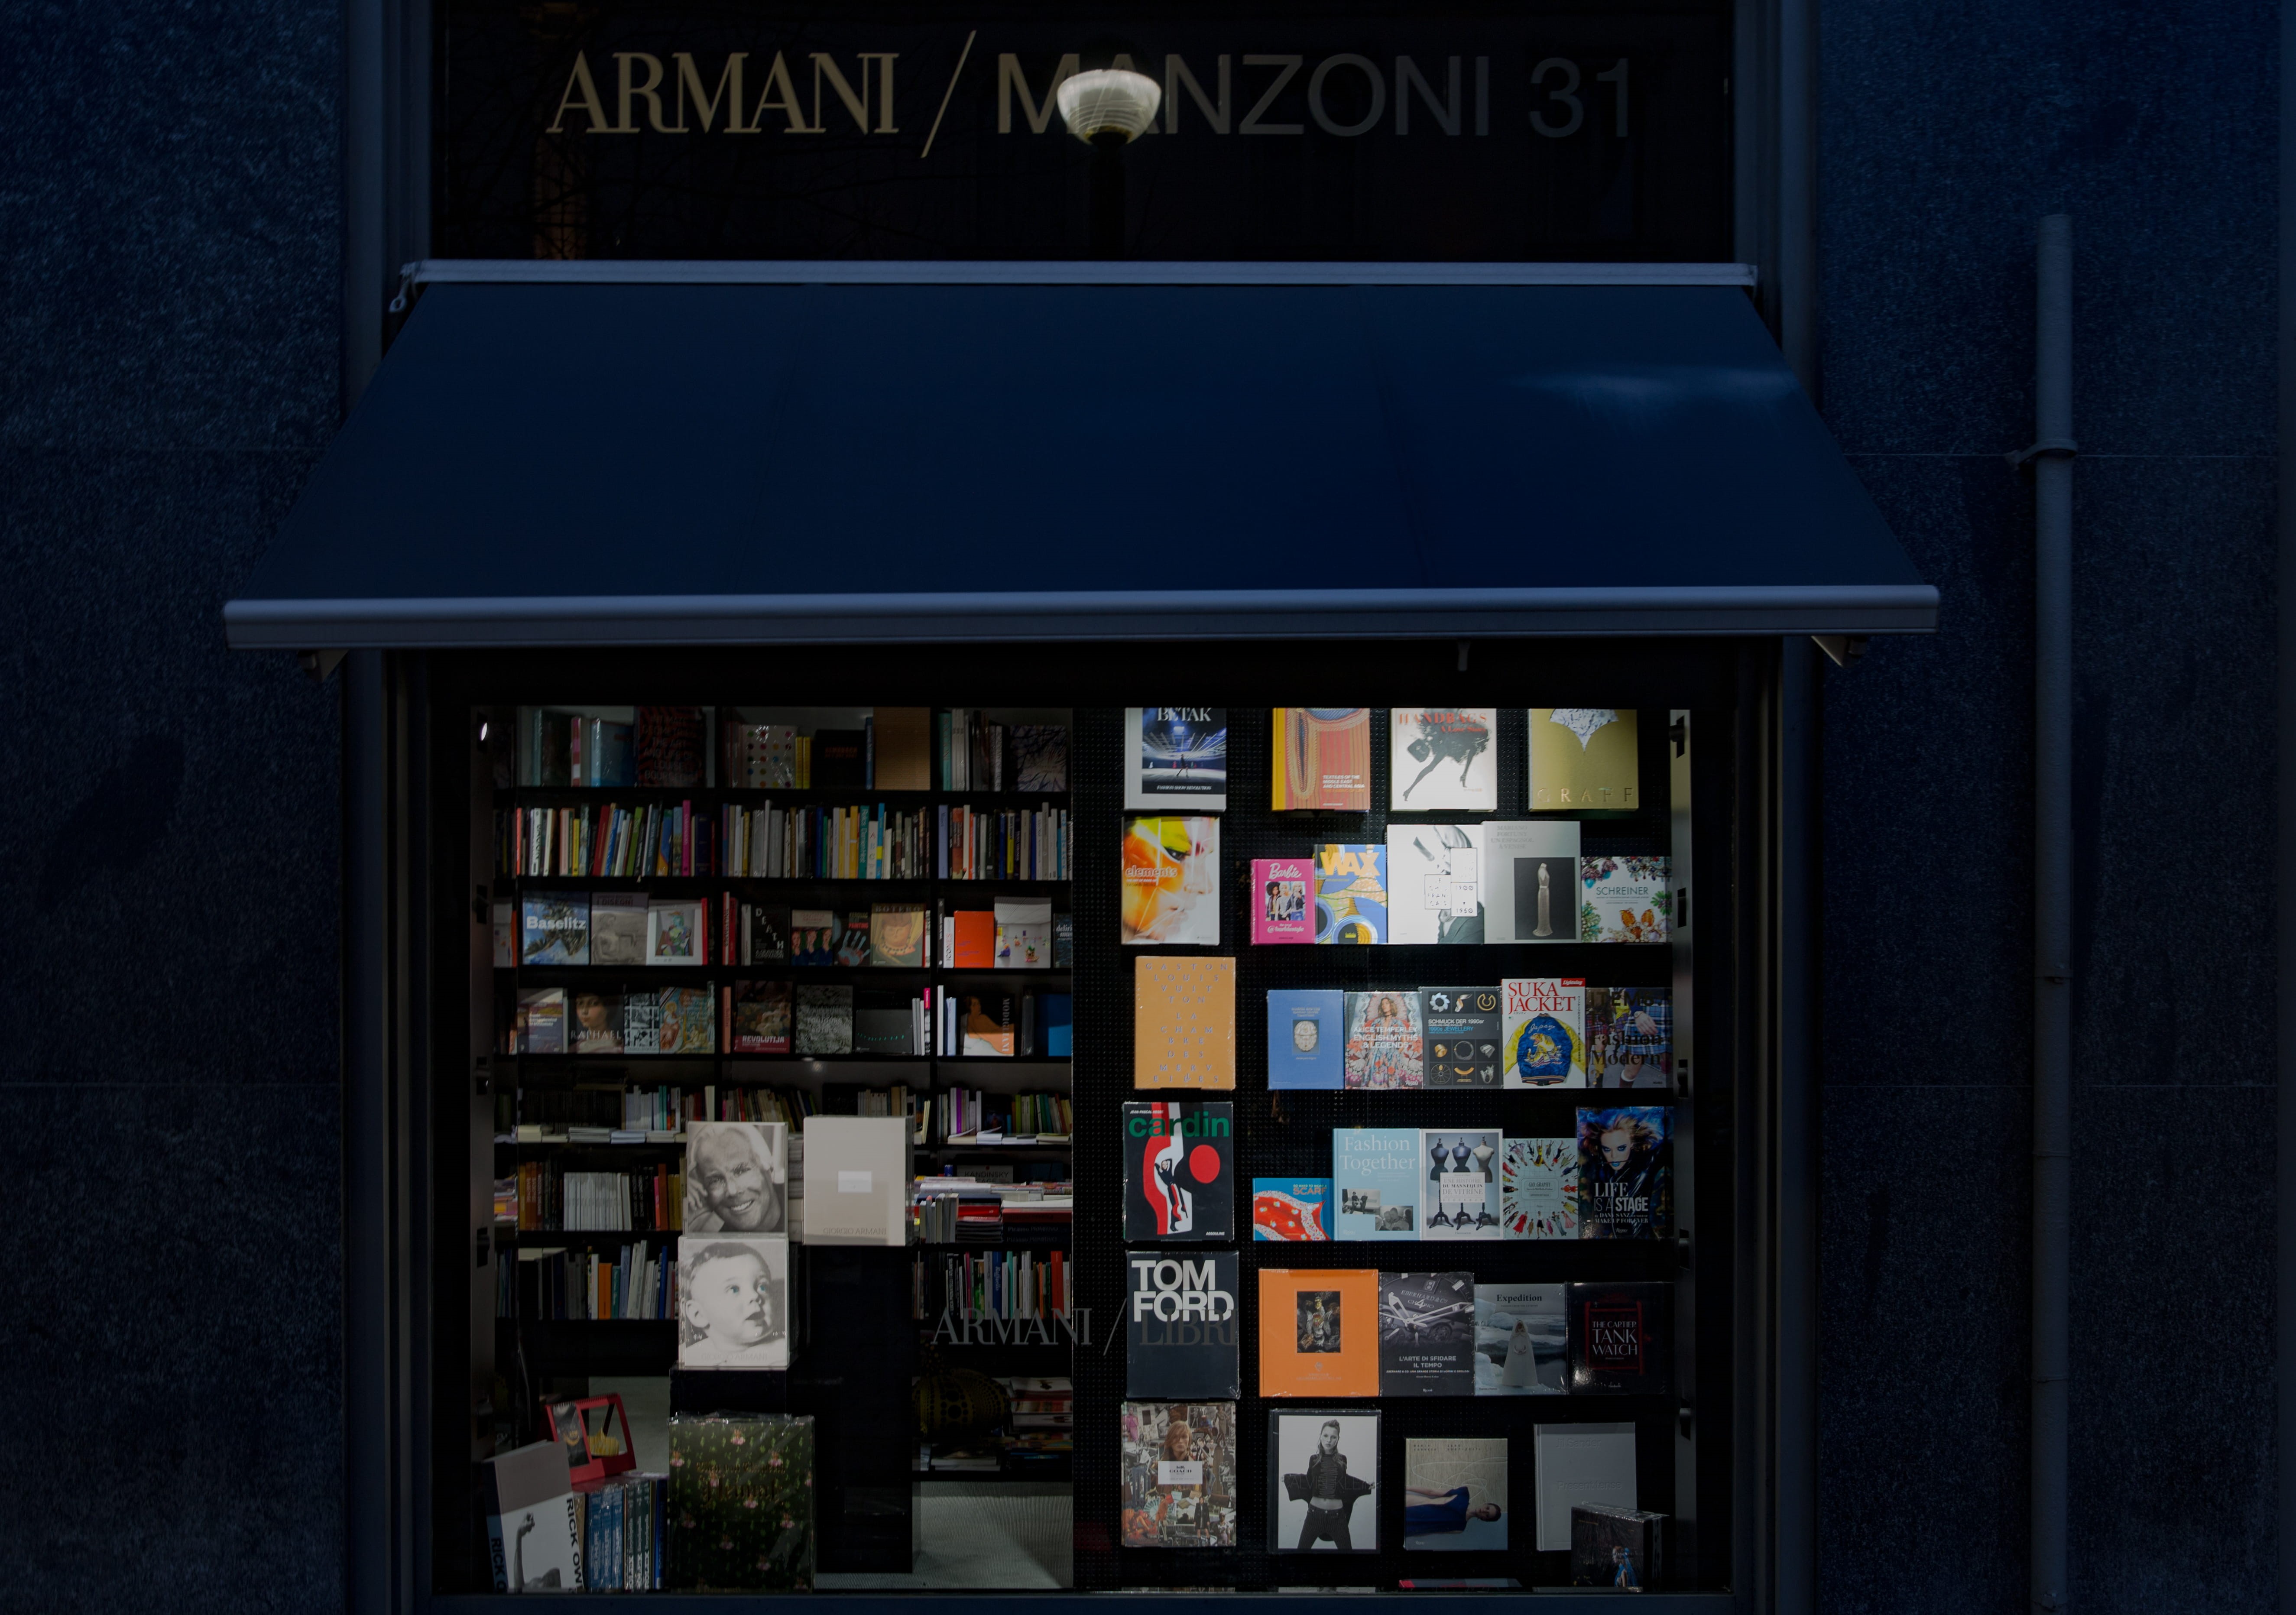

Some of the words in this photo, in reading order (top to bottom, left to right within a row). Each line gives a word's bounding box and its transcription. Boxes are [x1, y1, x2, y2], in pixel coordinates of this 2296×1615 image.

[545, 50, 900, 134] ARMANI
[1528, 58, 1630, 138] 31
[1157, 707, 1212, 722] BETAK
[1399, 713, 1487, 724] HANDBAGS
[1537, 787, 1633, 802] GRAFF
[1125, 865, 1178, 878] elements
[1268, 863, 1302, 880] Barbie
[1320, 852, 1381, 876] WAX
[1596, 887, 1649, 895] SCHREINER
[526, 916, 587, 930] Baselitz
[1508, 982, 1560, 997] SUKA
[1508, 996, 1576, 1015] JACKET
[1002, 997, 1011, 1052] MODIGLIANI
[1528, 1023, 1555, 1034] Japan
[571, 1030, 623, 1040] RAPHAEL
[1592, 1031, 1663, 1046] Fashion
[1591, 1050, 1662, 1065] Modern
[1128, 1110, 1230, 1138] cardin
[1344, 1135, 1410, 1151] Fashion
[1339, 1153, 1416, 1176] Together
[1293, 1187, 1327, 1195] SCARF
[1594, 1182, 1628, 1197] LIFE
[1615, 1197, 1649, 1212] STAGE
[1131, 1258, 1216, 1291] TOM
[1401, 1289, 1435, 1301] EBERHARD
[1497, 1294, 1542, 1304] Expedition
[1133, 1290, 1234, 1322] FORD
[930, 1307, 1092, 1346] ARMANI
[1139, 1308, 1238, 1346] LIBRI
[1592, 1329, 1638, 1343] TANK
[1592, 1344, 1638, 1356] WATCH
[1568, 1438, 1602, 1449] Sander
[1558, 1480, 1593, 1491] Present
[566, 1498, 578, 1547] RICK
[491, 1537, 506, 1576] RICK
